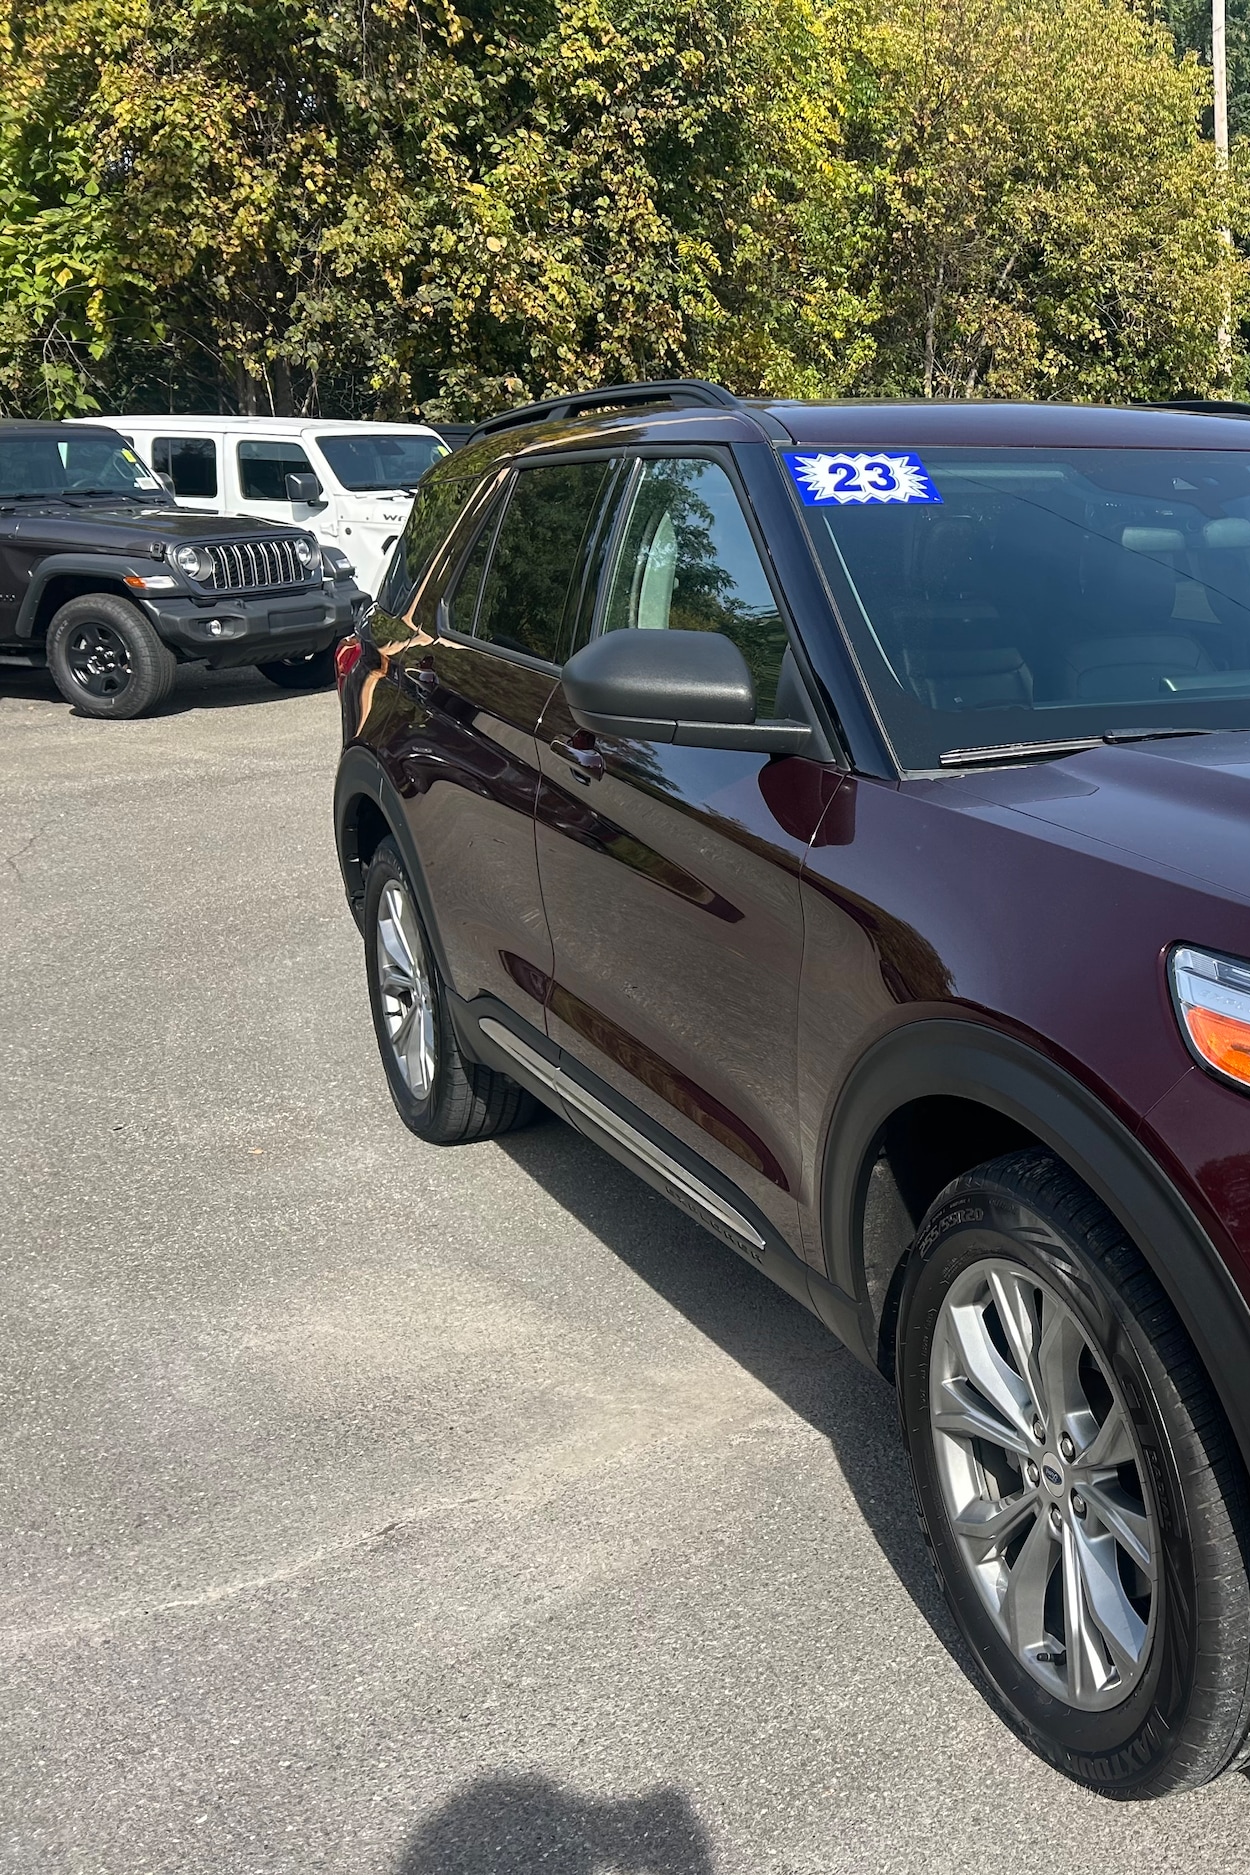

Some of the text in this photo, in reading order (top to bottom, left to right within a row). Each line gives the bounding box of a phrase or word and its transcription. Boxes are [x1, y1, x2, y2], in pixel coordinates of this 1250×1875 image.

[828, 462, 898, 492] 23
[664, 1185, 765, 1267] EXPLORER
[918, 1207, 984, 1259] 255/55R20
[1063, 1704, 1170, 1781] MAXTOUR
